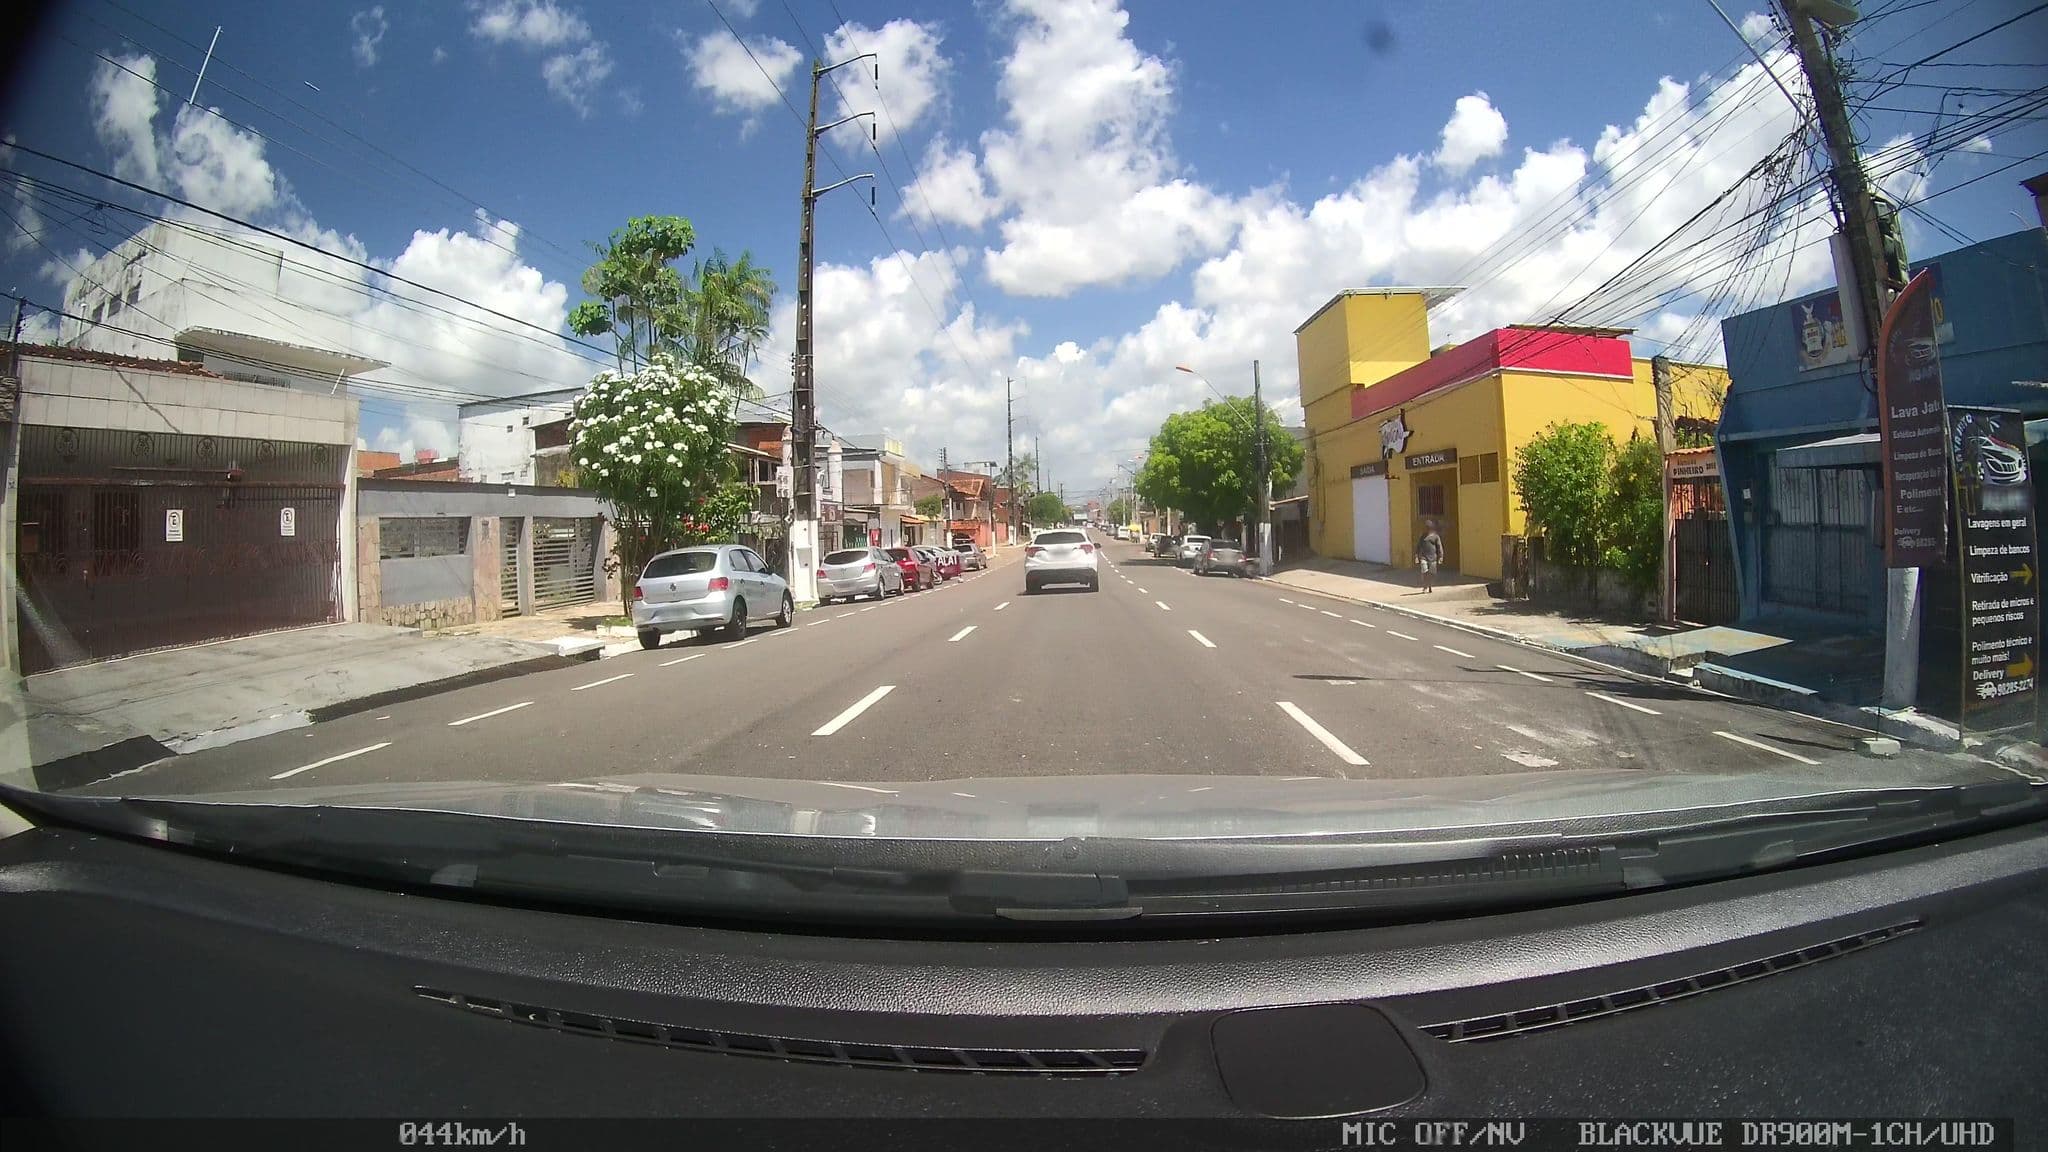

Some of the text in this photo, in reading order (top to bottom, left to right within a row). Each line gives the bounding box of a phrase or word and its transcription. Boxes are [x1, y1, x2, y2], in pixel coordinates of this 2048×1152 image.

[1891, 406, 1918, 418] Lava
[1412, 454, 1445, 466] ENTRADA
[1894, 451, 1919, 461] Limpeza
[1968, 516, 2027, 531] Lavagens em geral
[1969, 543, 2030, 558] Limpeza de bancos
[1970, 571, 2008, 584] Vitrificação
[1972, 597, 2034, 611] Retirada de micros e
[1972, 611, 2024, 628] pequenos riscos
[1972, 636, 2033, 652] Polimento técnico e
[1972, 650, 2010, 665] muito mais!
[1973, 669, 2004, 680] Delivery
